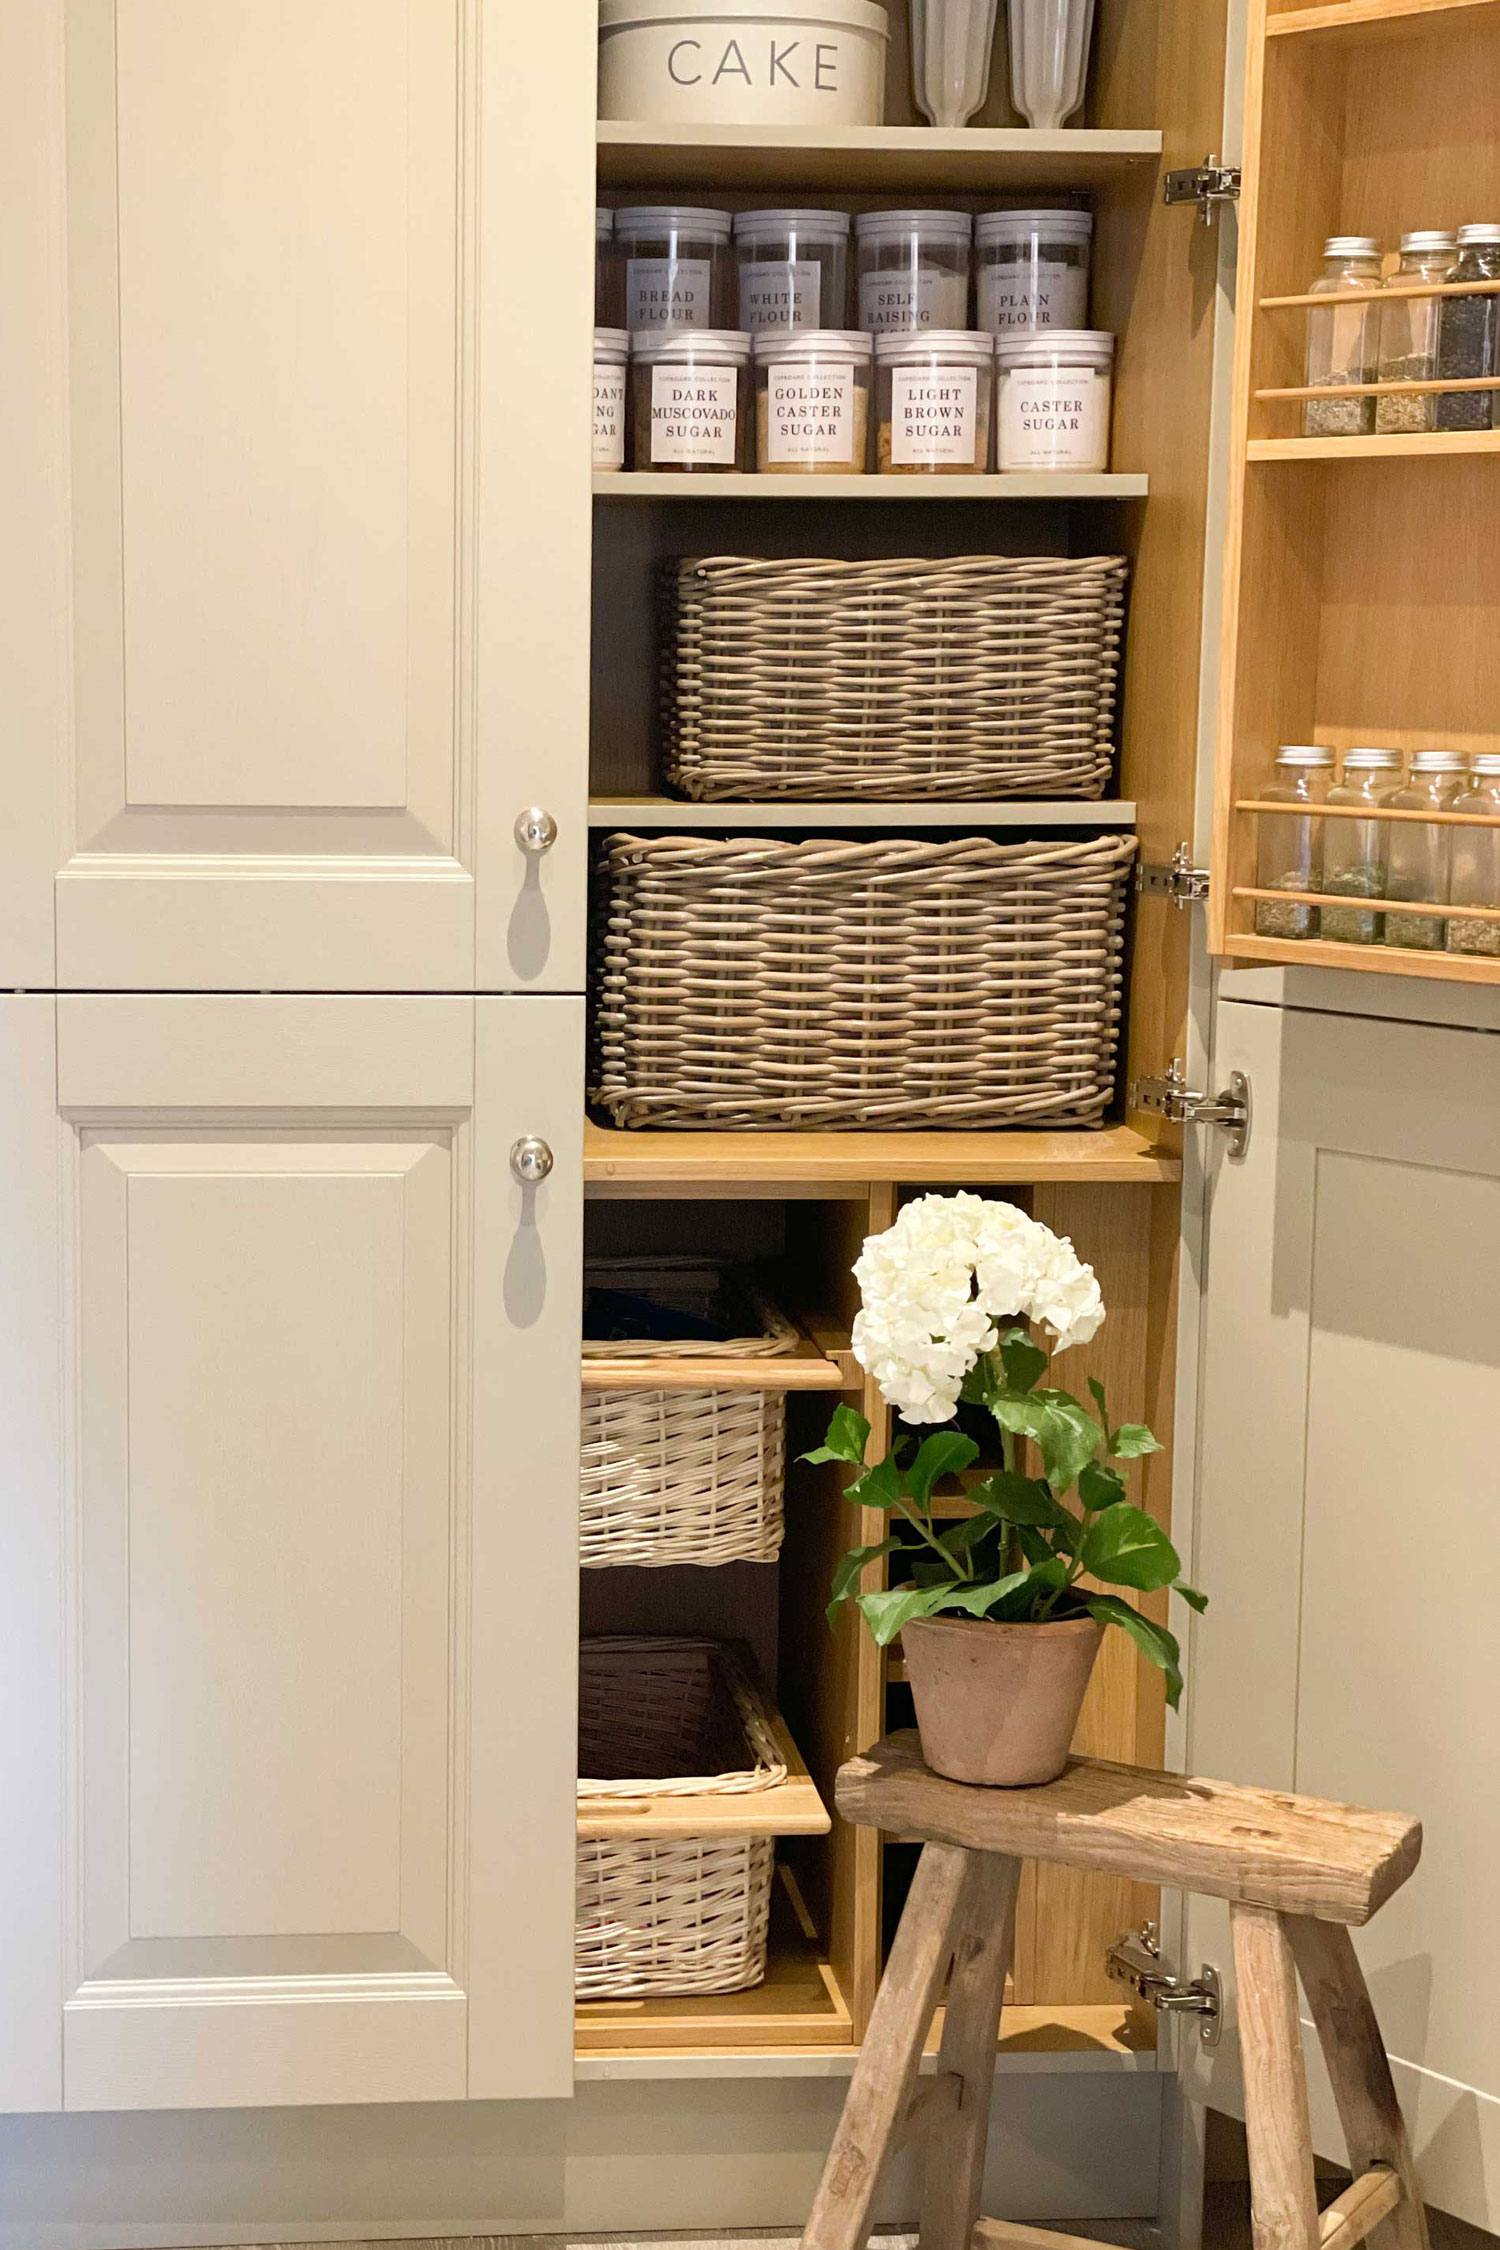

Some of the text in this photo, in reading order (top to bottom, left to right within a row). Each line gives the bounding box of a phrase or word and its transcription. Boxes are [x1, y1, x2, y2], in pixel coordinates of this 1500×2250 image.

[668, 39, 838, 91] CAKE
[639, 290, 695, 303] BREAD
[749, 293, 802, 304] WHITE
[1000, 294, 1050, 307] PLAN
[639, 308, 694, 320] FLOUR
[749, 311, 802, 323] FLOUR
[673, 389, 718, 401] DARK
[775, 387, 843, 400] GOLDEN
[908, 389, 961, 401] LIGHT
[777, 405, 841, 418] CASTER
[904, 407, 964, 419] BROWN
[1020, 400, 1083, 413] CASTER
[652, 407, 736, 420] MUSCOVADO
[781, 424, 837, 436] SUGAR
[905, 425, 962, 437] SUGAR
[1023, 418, 1079, 431] SUGAR
[666, 425, 722, 438] SUGAR
